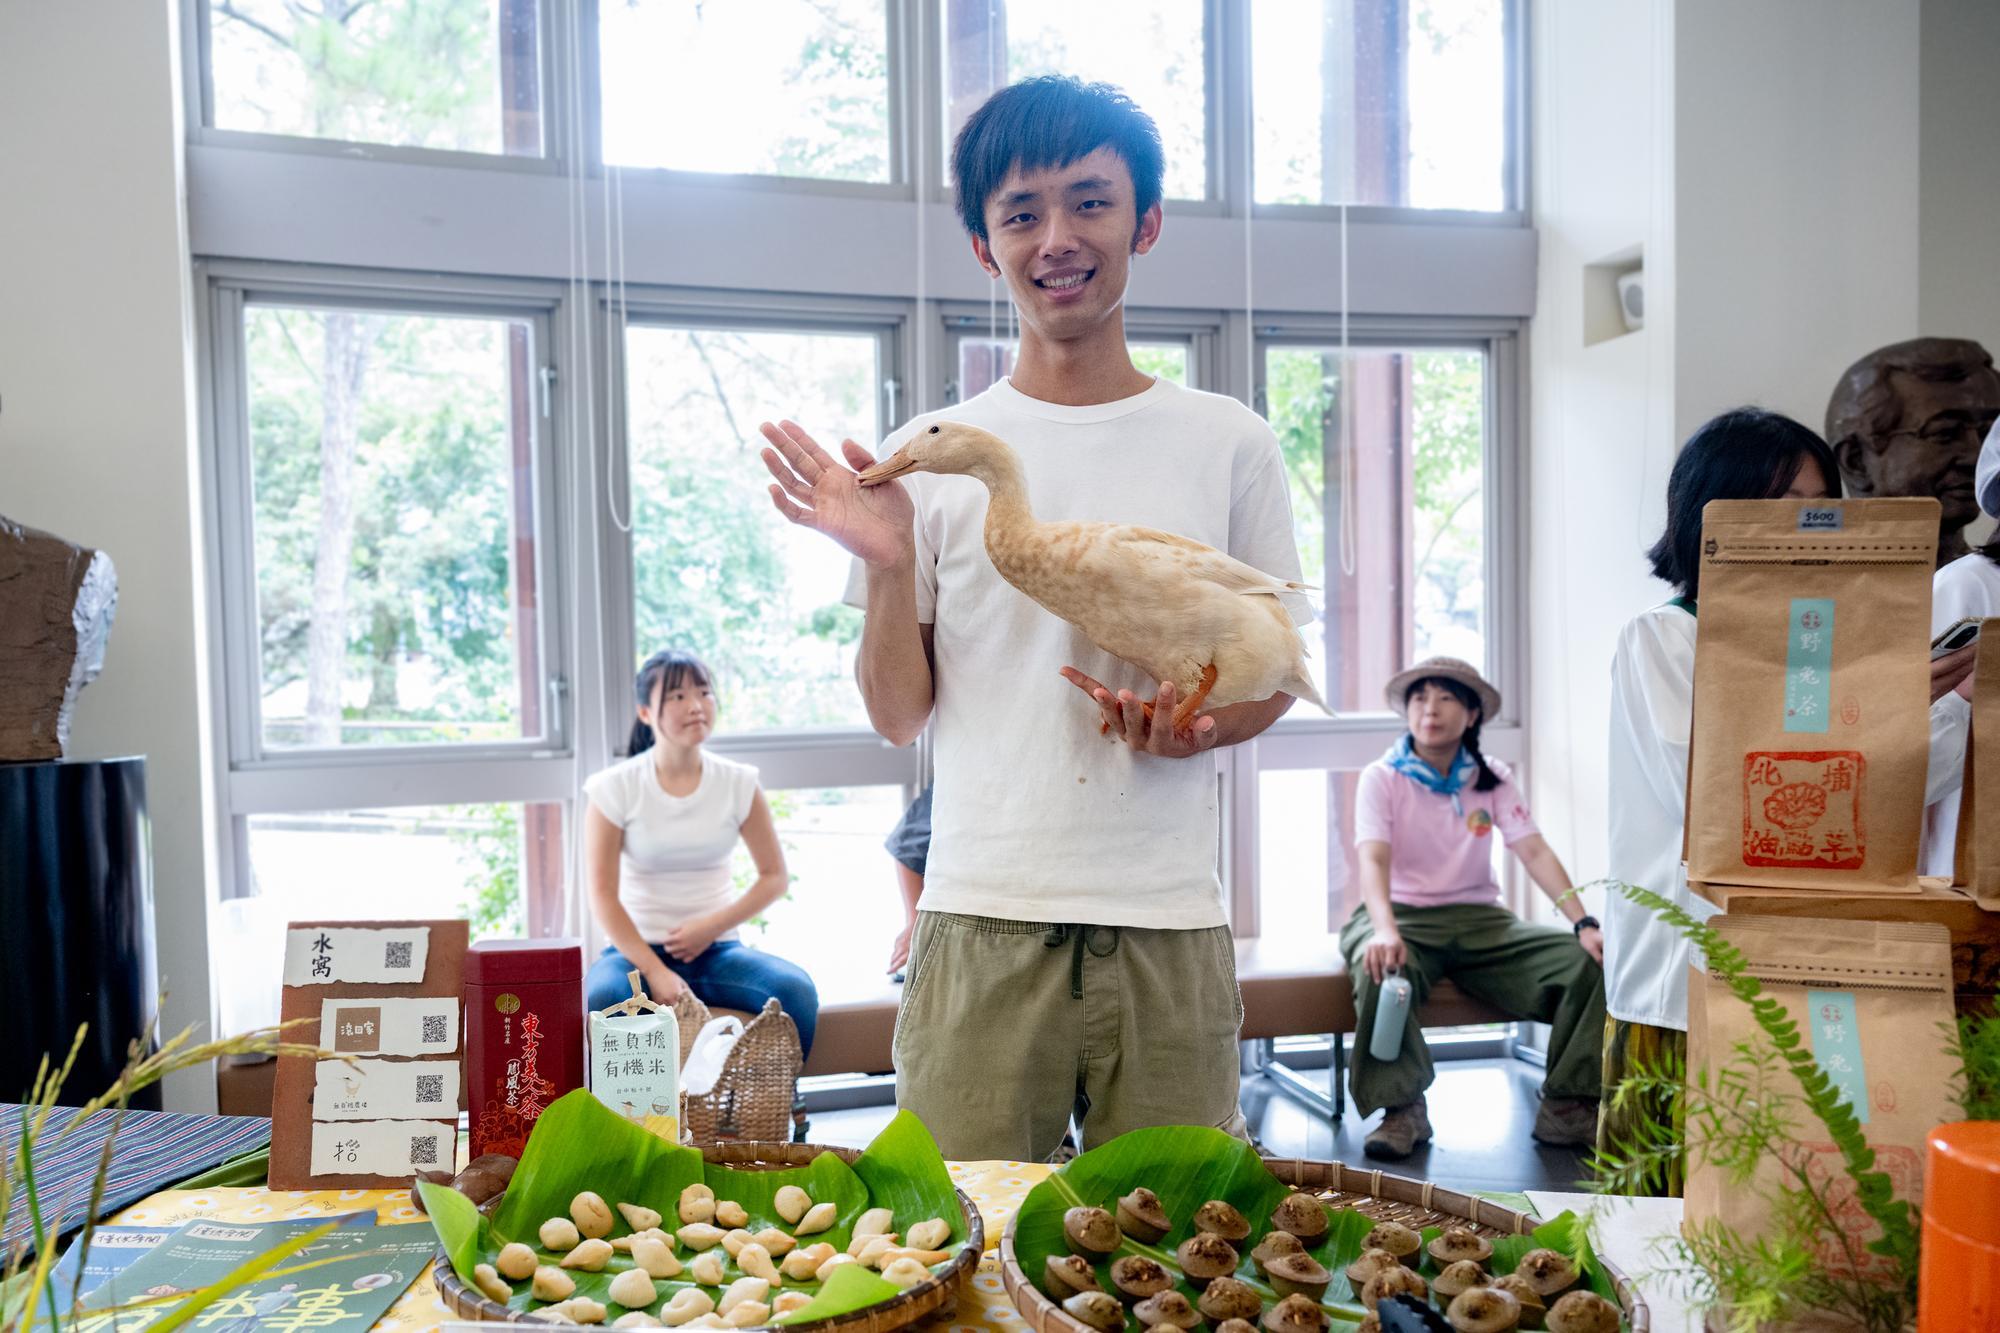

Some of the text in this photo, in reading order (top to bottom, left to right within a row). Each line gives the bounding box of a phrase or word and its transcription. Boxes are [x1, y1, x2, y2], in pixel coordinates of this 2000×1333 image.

[1806, 512, 1834, 521] $600
[1797, 632, 1822, 716] 野兔茶
[312, 933, 334, 978] 水窩
[602, 1030, 666, 1053] 無負擔
[517, 1012, 546, 1121] 東方美人茶
[604, 1059, 665, 1078] 有機米
